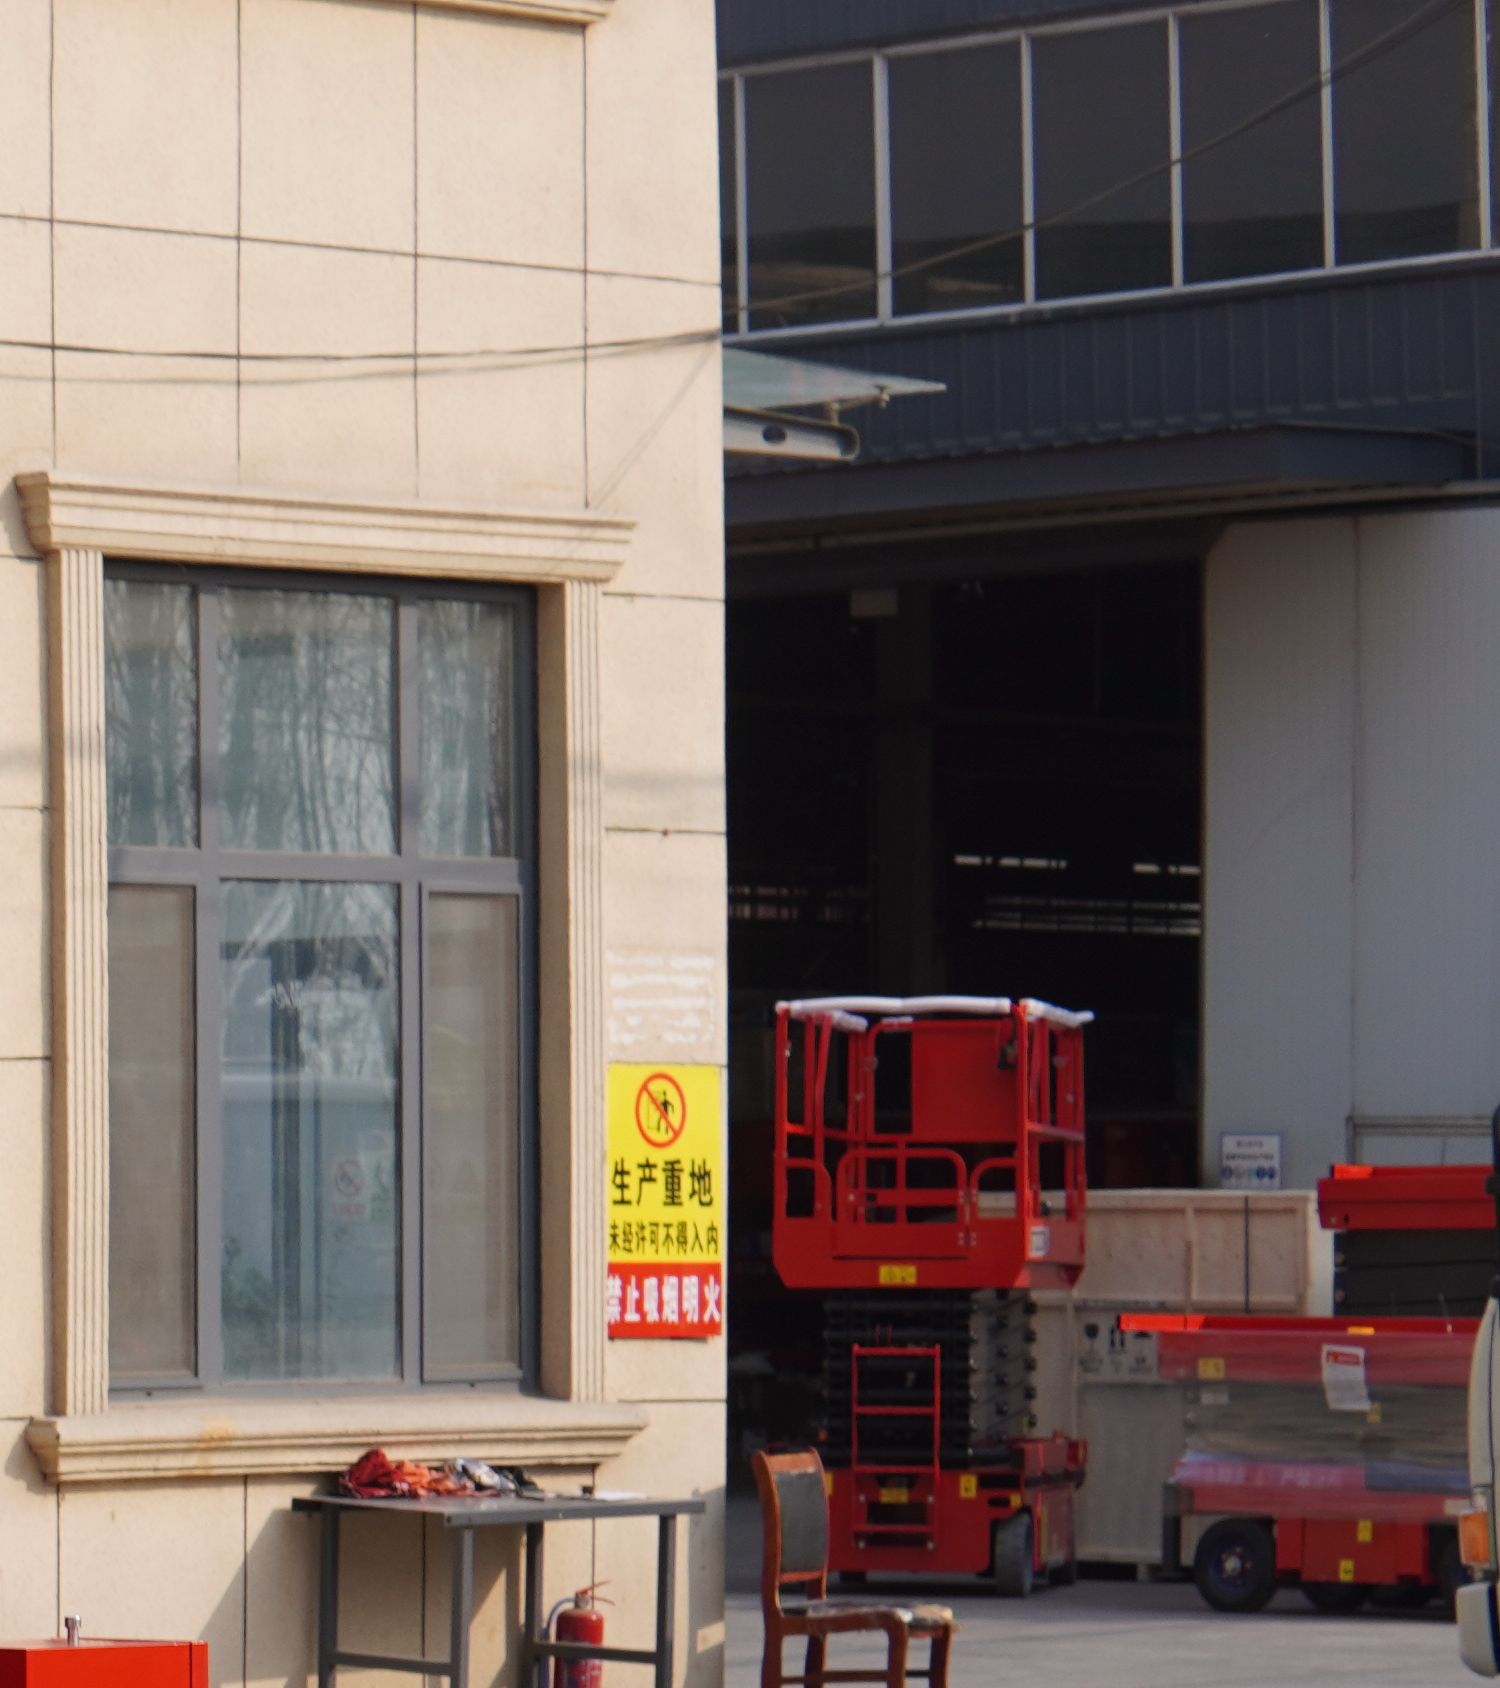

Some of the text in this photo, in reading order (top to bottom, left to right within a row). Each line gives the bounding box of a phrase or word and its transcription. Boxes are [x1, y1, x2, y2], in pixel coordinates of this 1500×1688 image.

[611, 1157, 713, 1207] 生产重地
[608, 1219, 719, 1255] 未经许可不得入内
[607, 1274, 721, 1325] 禁止吸烟明火
